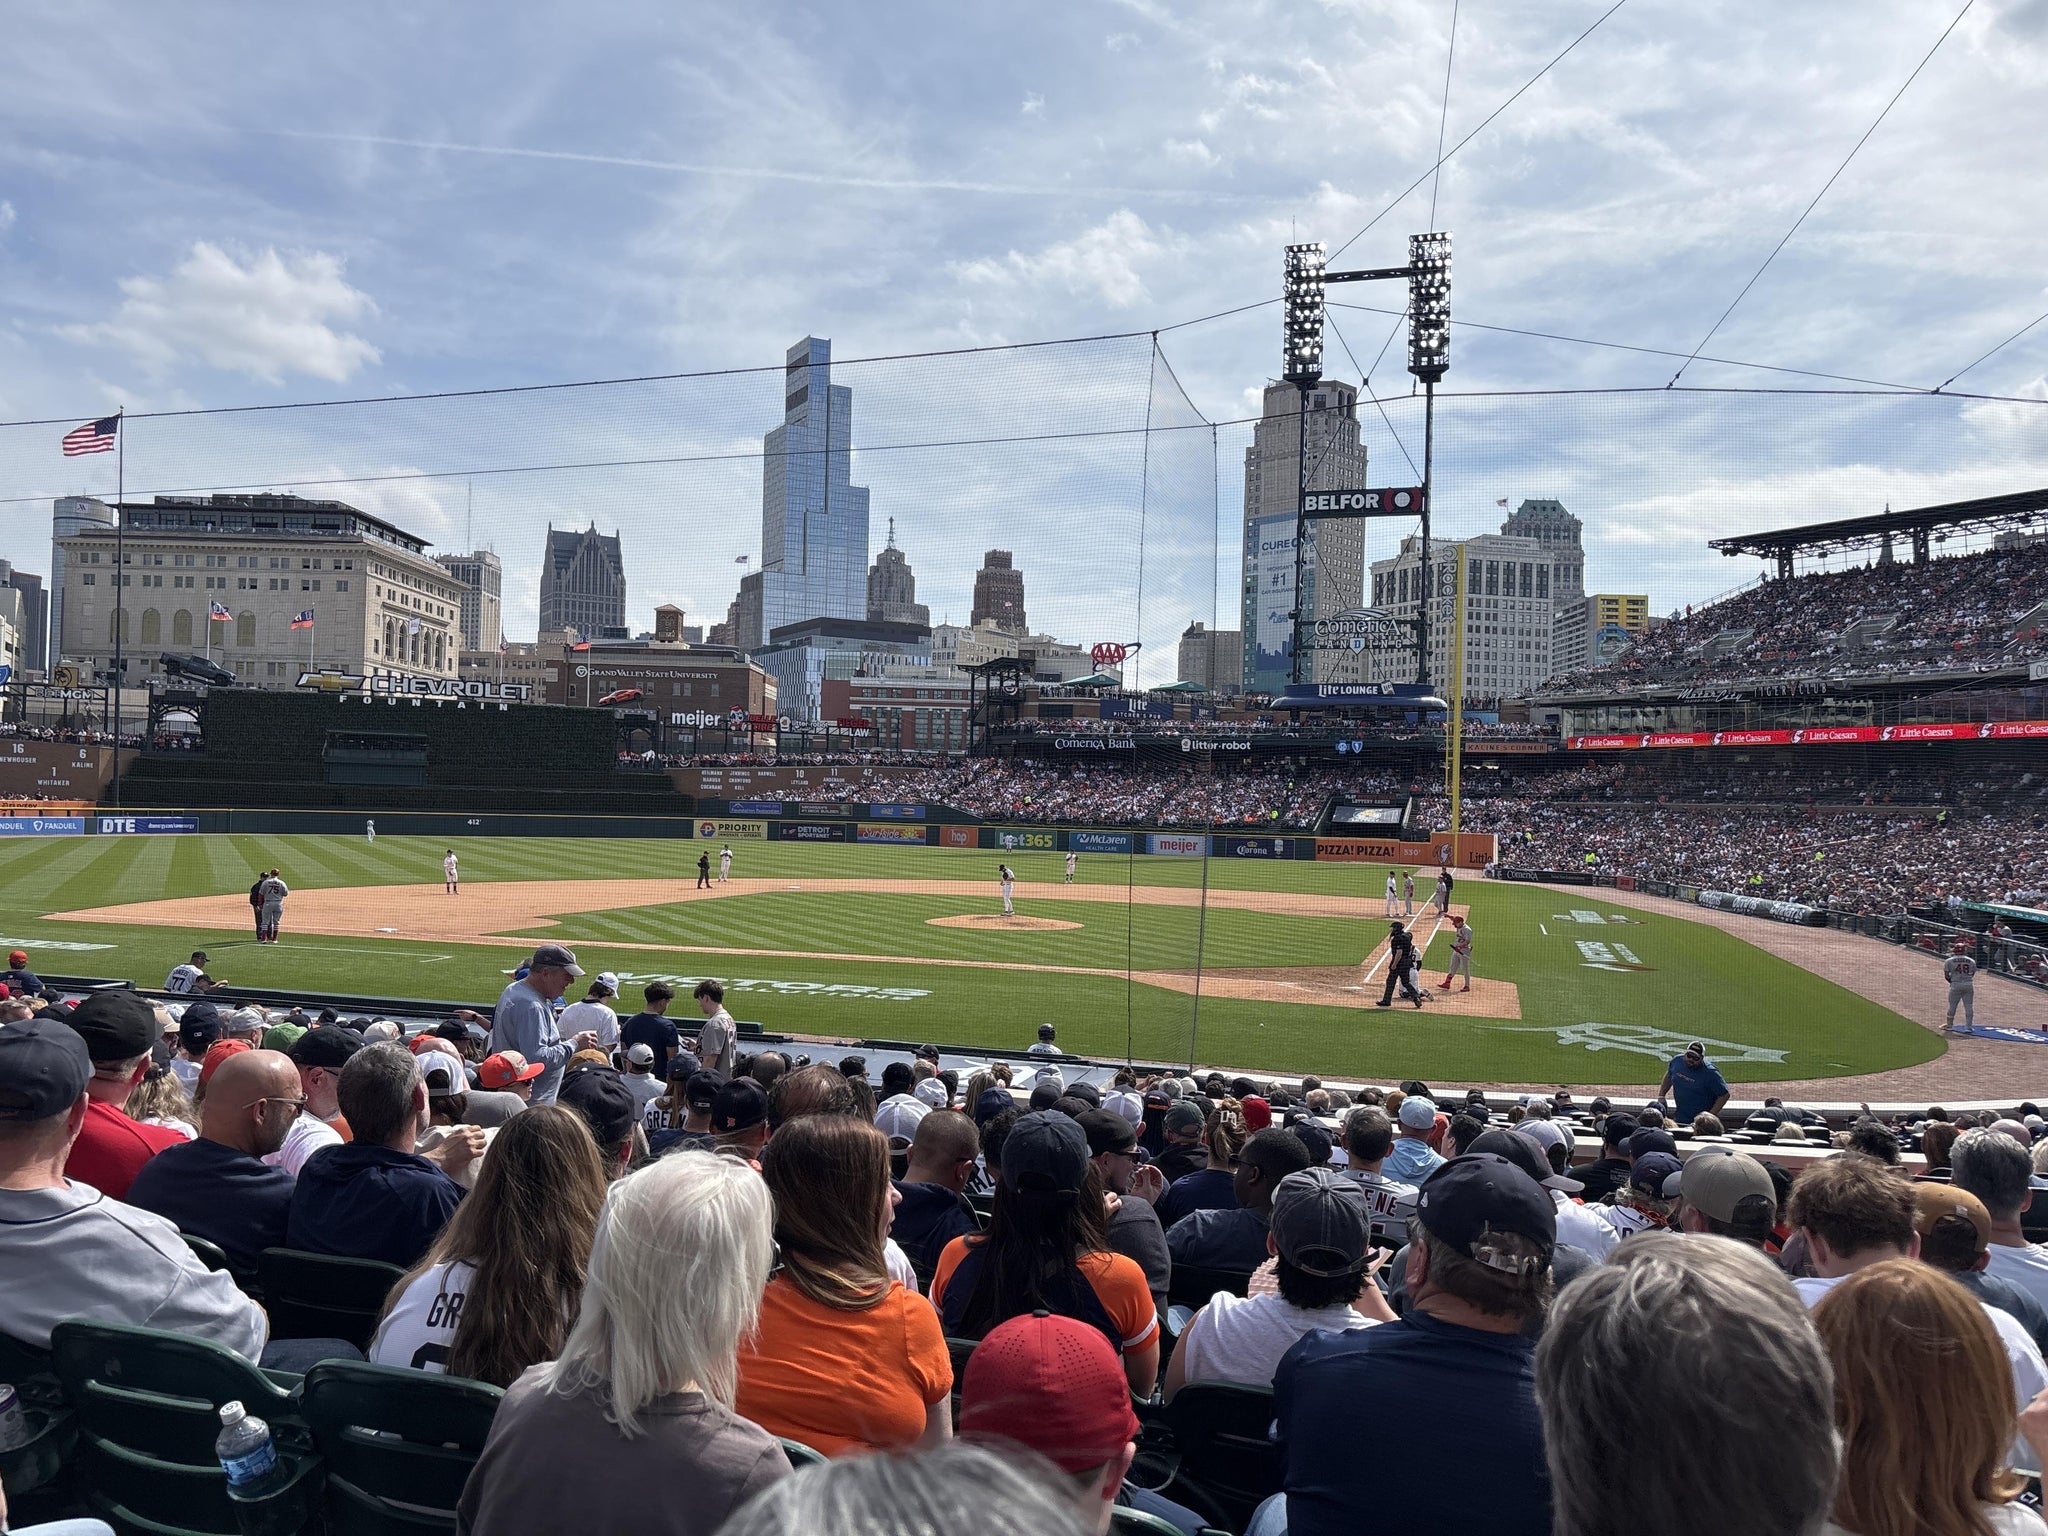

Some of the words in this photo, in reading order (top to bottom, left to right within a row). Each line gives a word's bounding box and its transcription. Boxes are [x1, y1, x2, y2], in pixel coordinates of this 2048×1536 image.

[1305, 494, 1379, 511] BELFOR
[1262, 540, 1290, 551] CURE
[1272, 573, 1286, 586] #1
[1315, 638, 1402, 650] LANDING
[1093, 643, 1124, 664] AAA
[617, 669, 645, 678] VALLEY
[645, 670, 669, 678] STATE
[669, 670, 719, 679] UNIVERSITY
[371, 676, 533, 700] CHEVROLET
[1318, 684, 1339, 698] Lite
[1340, 685, 1378, 695] LOUNGE
[1753, 686, 1786, 697] TIGER
[1799, 683, 1827, 695] CLUB
[1677, 688, 1716, 700] Motor
[1716, 689, 1743, 702] City
[339, 695, 508, 711] FOUNTAIN
[1128, 699, 1147, 712] Lite
[671, 710, 721, 729] meijer
[849, 728, 870, 737] LAW
[1900, 729, 1921, 738] Little
[1922, 728, 1953, 737] Caesars
[2000, 725, 2023, 734] Little
[1654, 737, 1671, 745] Little
[1671, 736, 1694, 744] Caesars
[1728, 734, 1747, 743] Little
[1749, 734, 1771, 742] Caesars
[1809, 732, 1829, 741] Little
[1830, 731, 1858, 740] Caesars
[1108, 739, 1136, 749] Bank
[1603, 738, 1624, 746] Caesars
[12, 743, 25, 754] 16
[79, 749, 87, 759] 6
[52, 767, 57, 777] 1
[795, 770, 805, 778] 10
[830, 768, 838, 776] 11
[863, 769, 872, 777] 42
[102, 819, 136, 833] DTE
[718, 823, 762, 832] PRIORITY
[798, 826, 830, 834] DETROIT
[862, 827, 899, 840] Surfside
[1089, 834, 1127, 845] McLaren
[1159, 838, 1198, 854] meijer
[1236, 845, 1268, 856] Corona
[1317, 844, 1354, 856] PIZZA!
[1357, 845, 1395, 857] PIZZA!
[269, 886, 280, 895] 75
[1955, 964, 1970, 974] 48
[172, 977, 186, 991] 77
[617, 972, 934, 997] VICTORS
[1364, 1189, 1398, 1217] ENE
[426, 1292, 466, 1329] GR
